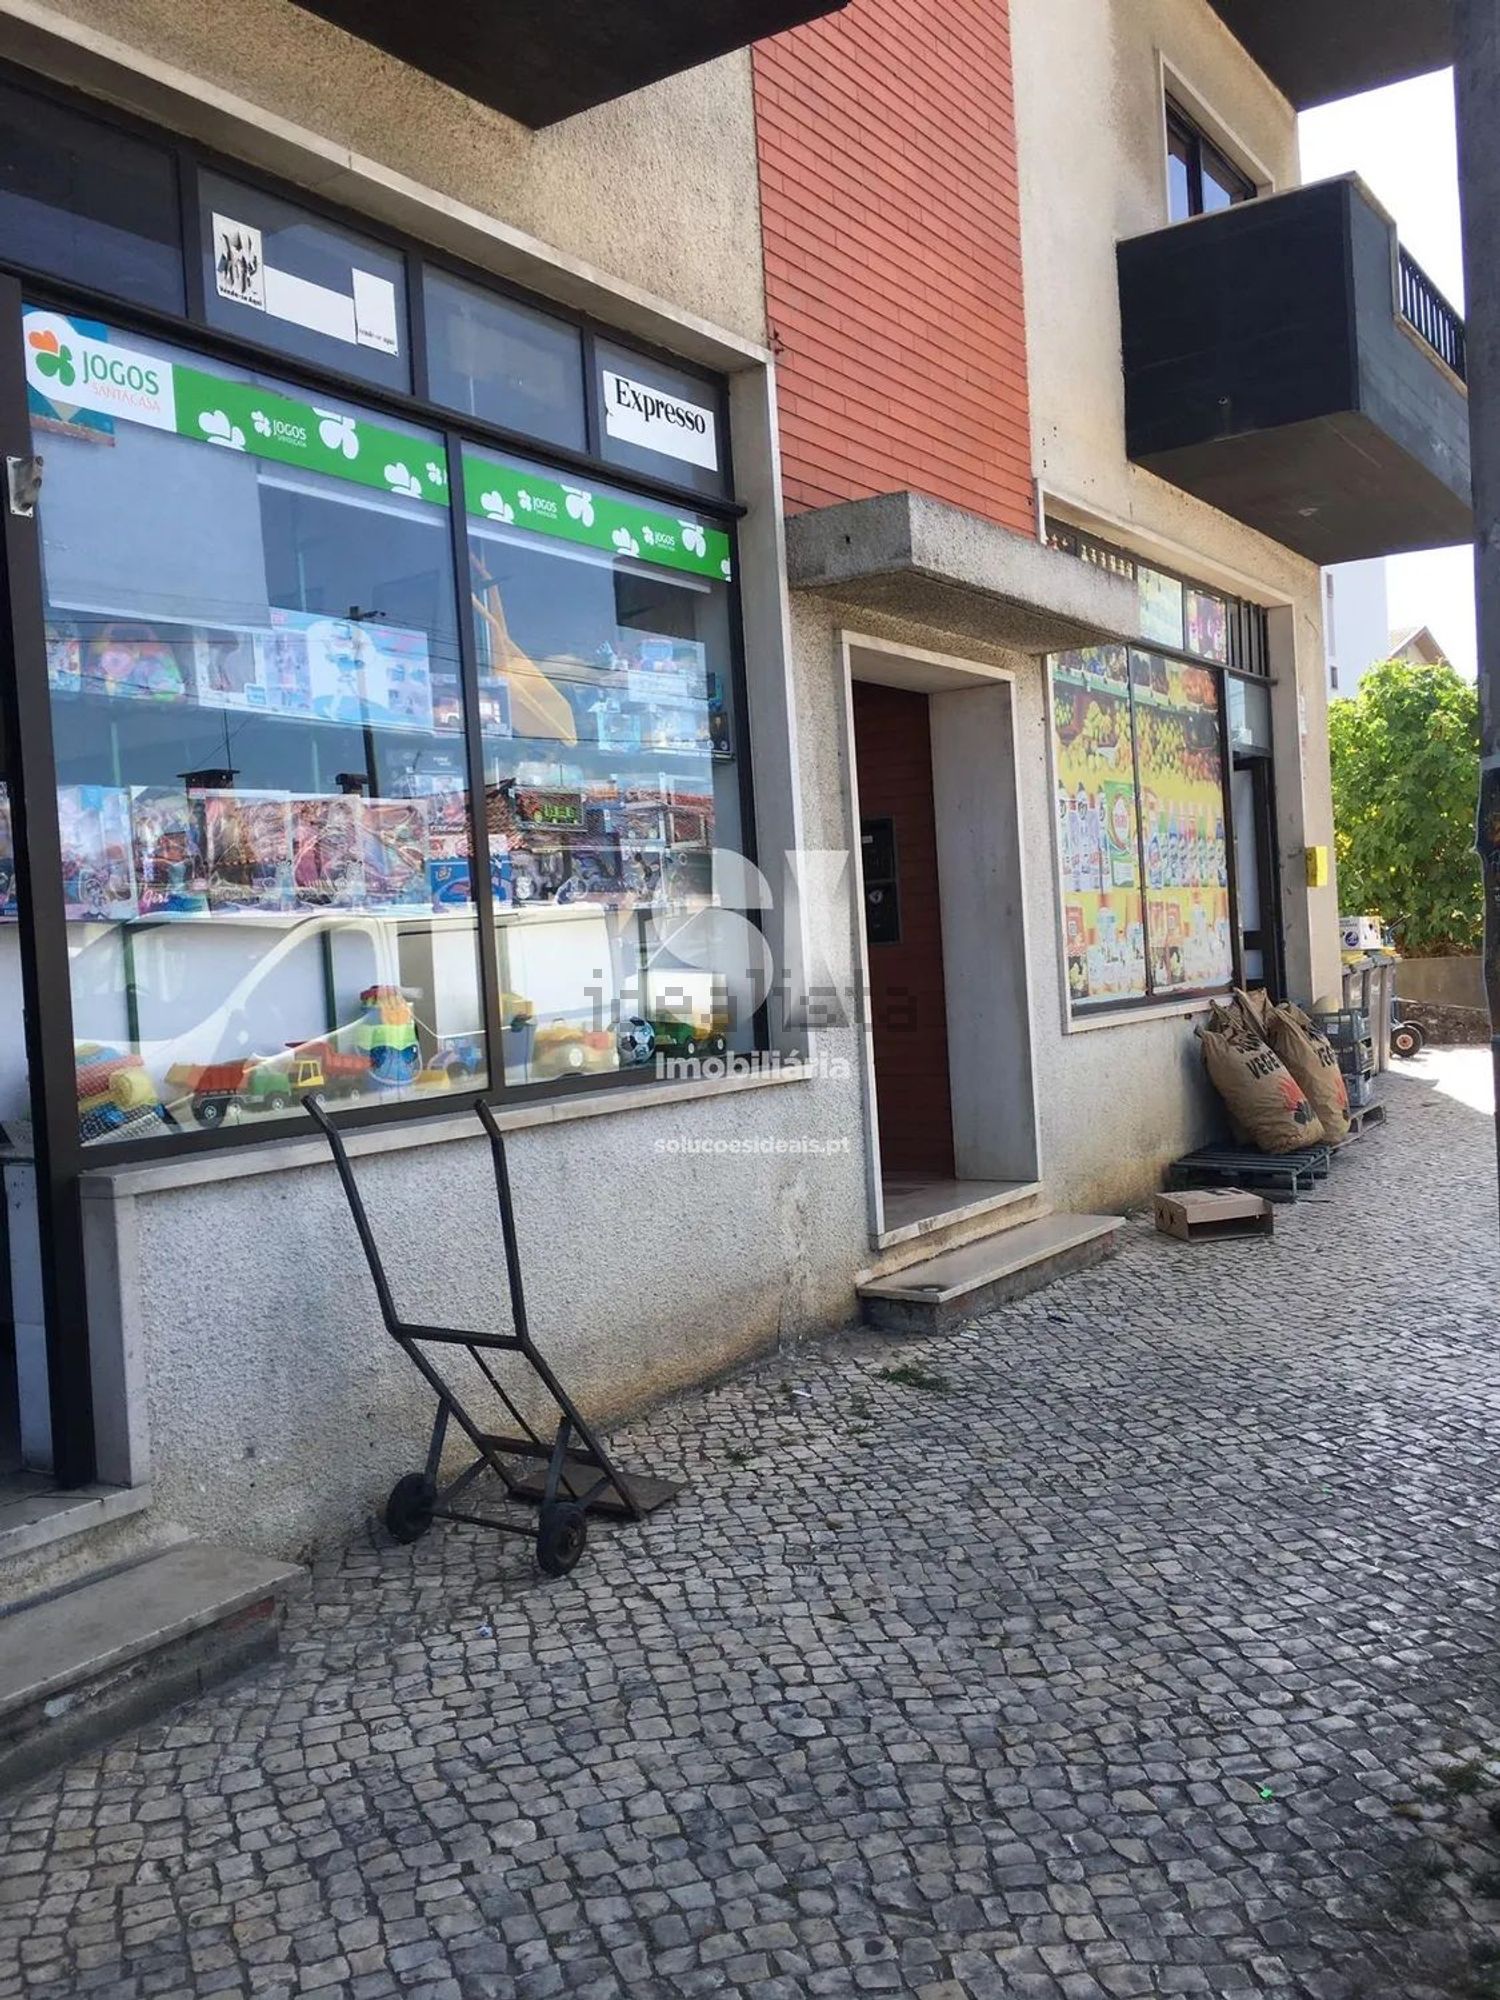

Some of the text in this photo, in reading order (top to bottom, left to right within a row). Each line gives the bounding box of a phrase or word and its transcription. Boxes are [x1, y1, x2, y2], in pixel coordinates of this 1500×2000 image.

[82, 350, 160, 396] JOGOS
[614, 377, 706, 434] Expresso
[272, 419, 308, 440] JOGOS
